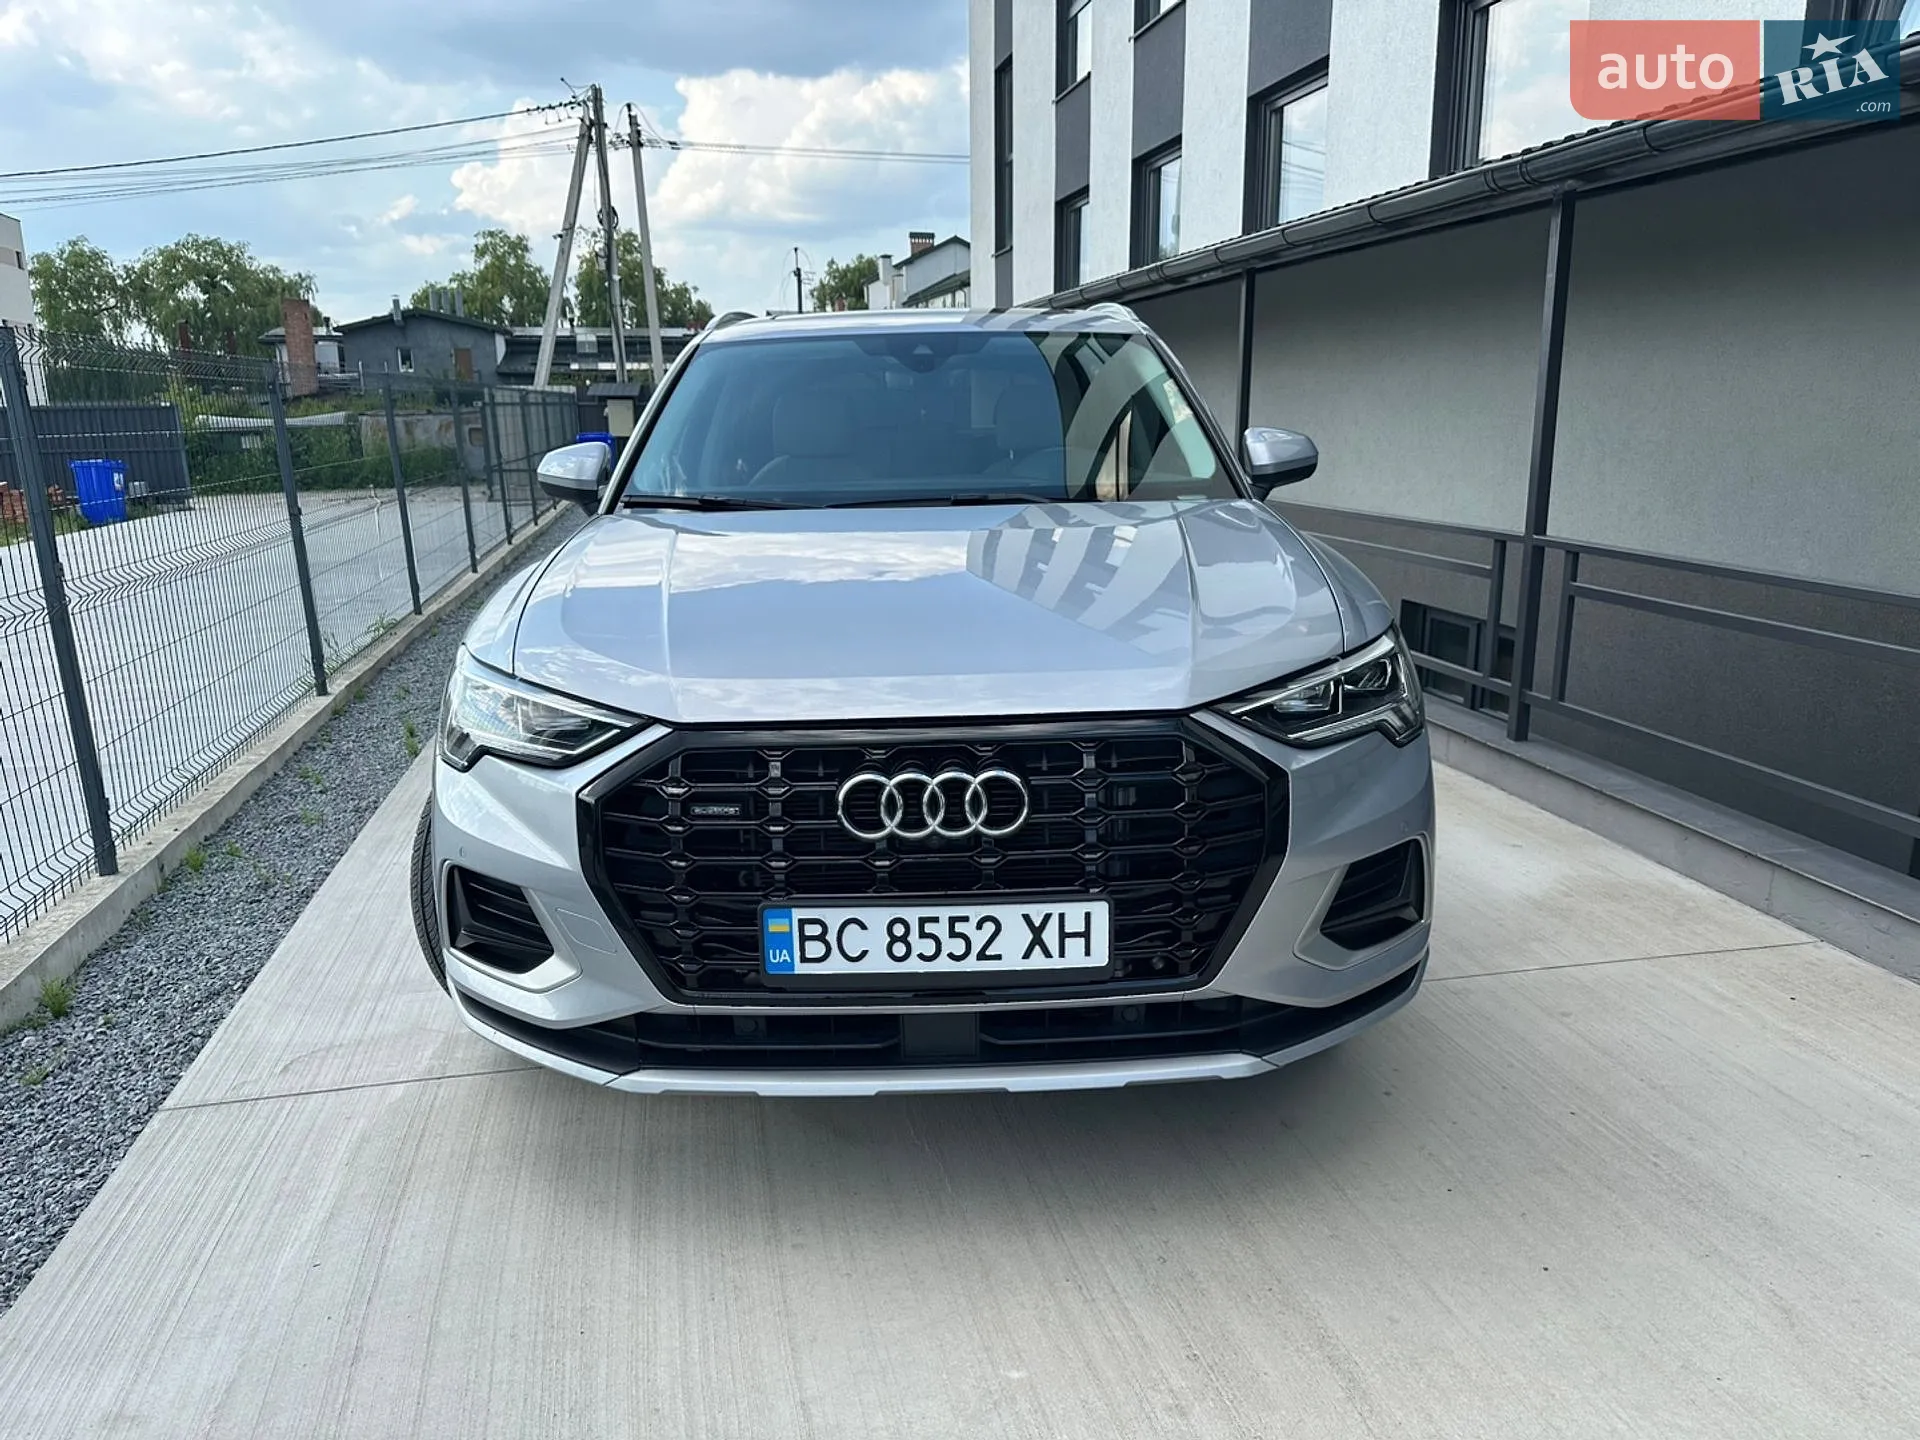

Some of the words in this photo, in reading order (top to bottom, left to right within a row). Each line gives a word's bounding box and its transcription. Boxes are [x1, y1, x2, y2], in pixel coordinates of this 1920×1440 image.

[797, 917, 869, 964] BC
[885, 914, 1003, 962] 8552
[1020, 911, 1091, 960] XH
[769, 949, 791, 963] UA
